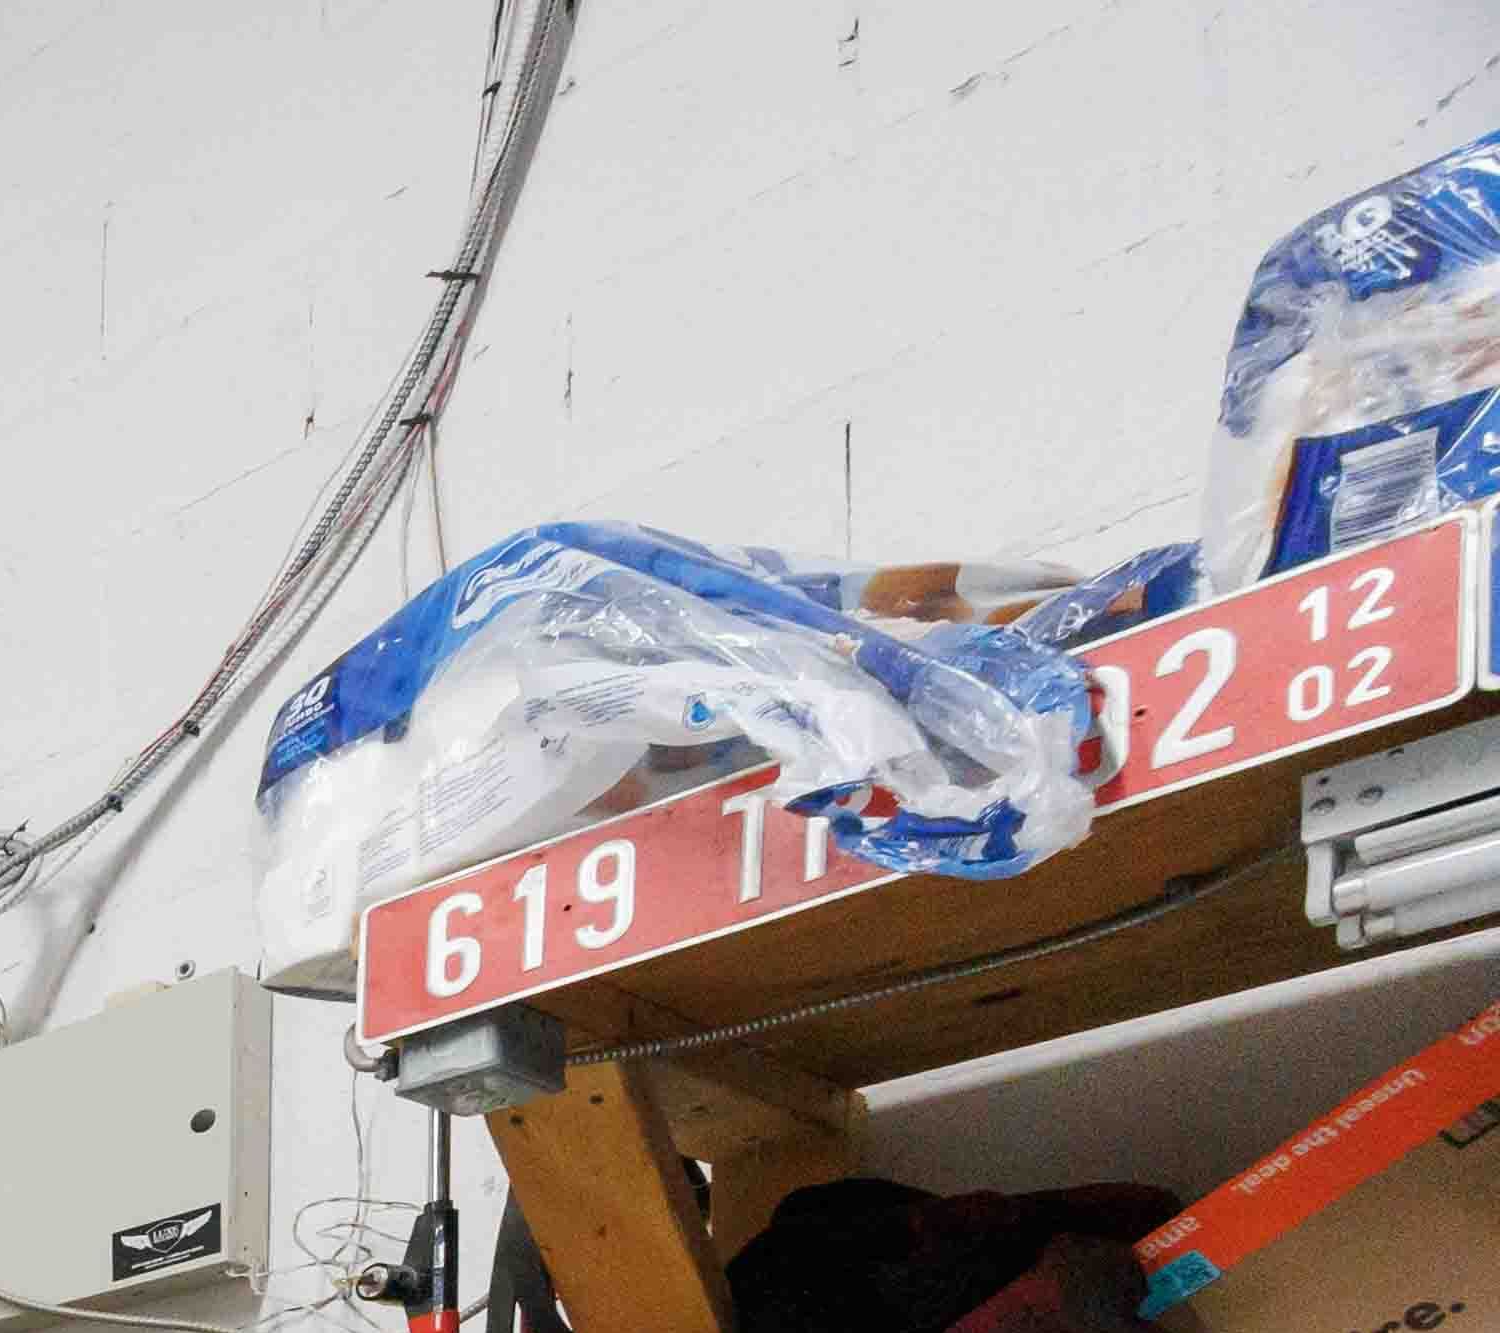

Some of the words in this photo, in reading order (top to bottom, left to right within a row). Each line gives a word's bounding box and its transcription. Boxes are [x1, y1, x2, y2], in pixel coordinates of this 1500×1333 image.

[1298, 567, 1395, 643] 12
[1286, 645, 1393, 724] 02
[425, 838, 637, 999] 619
